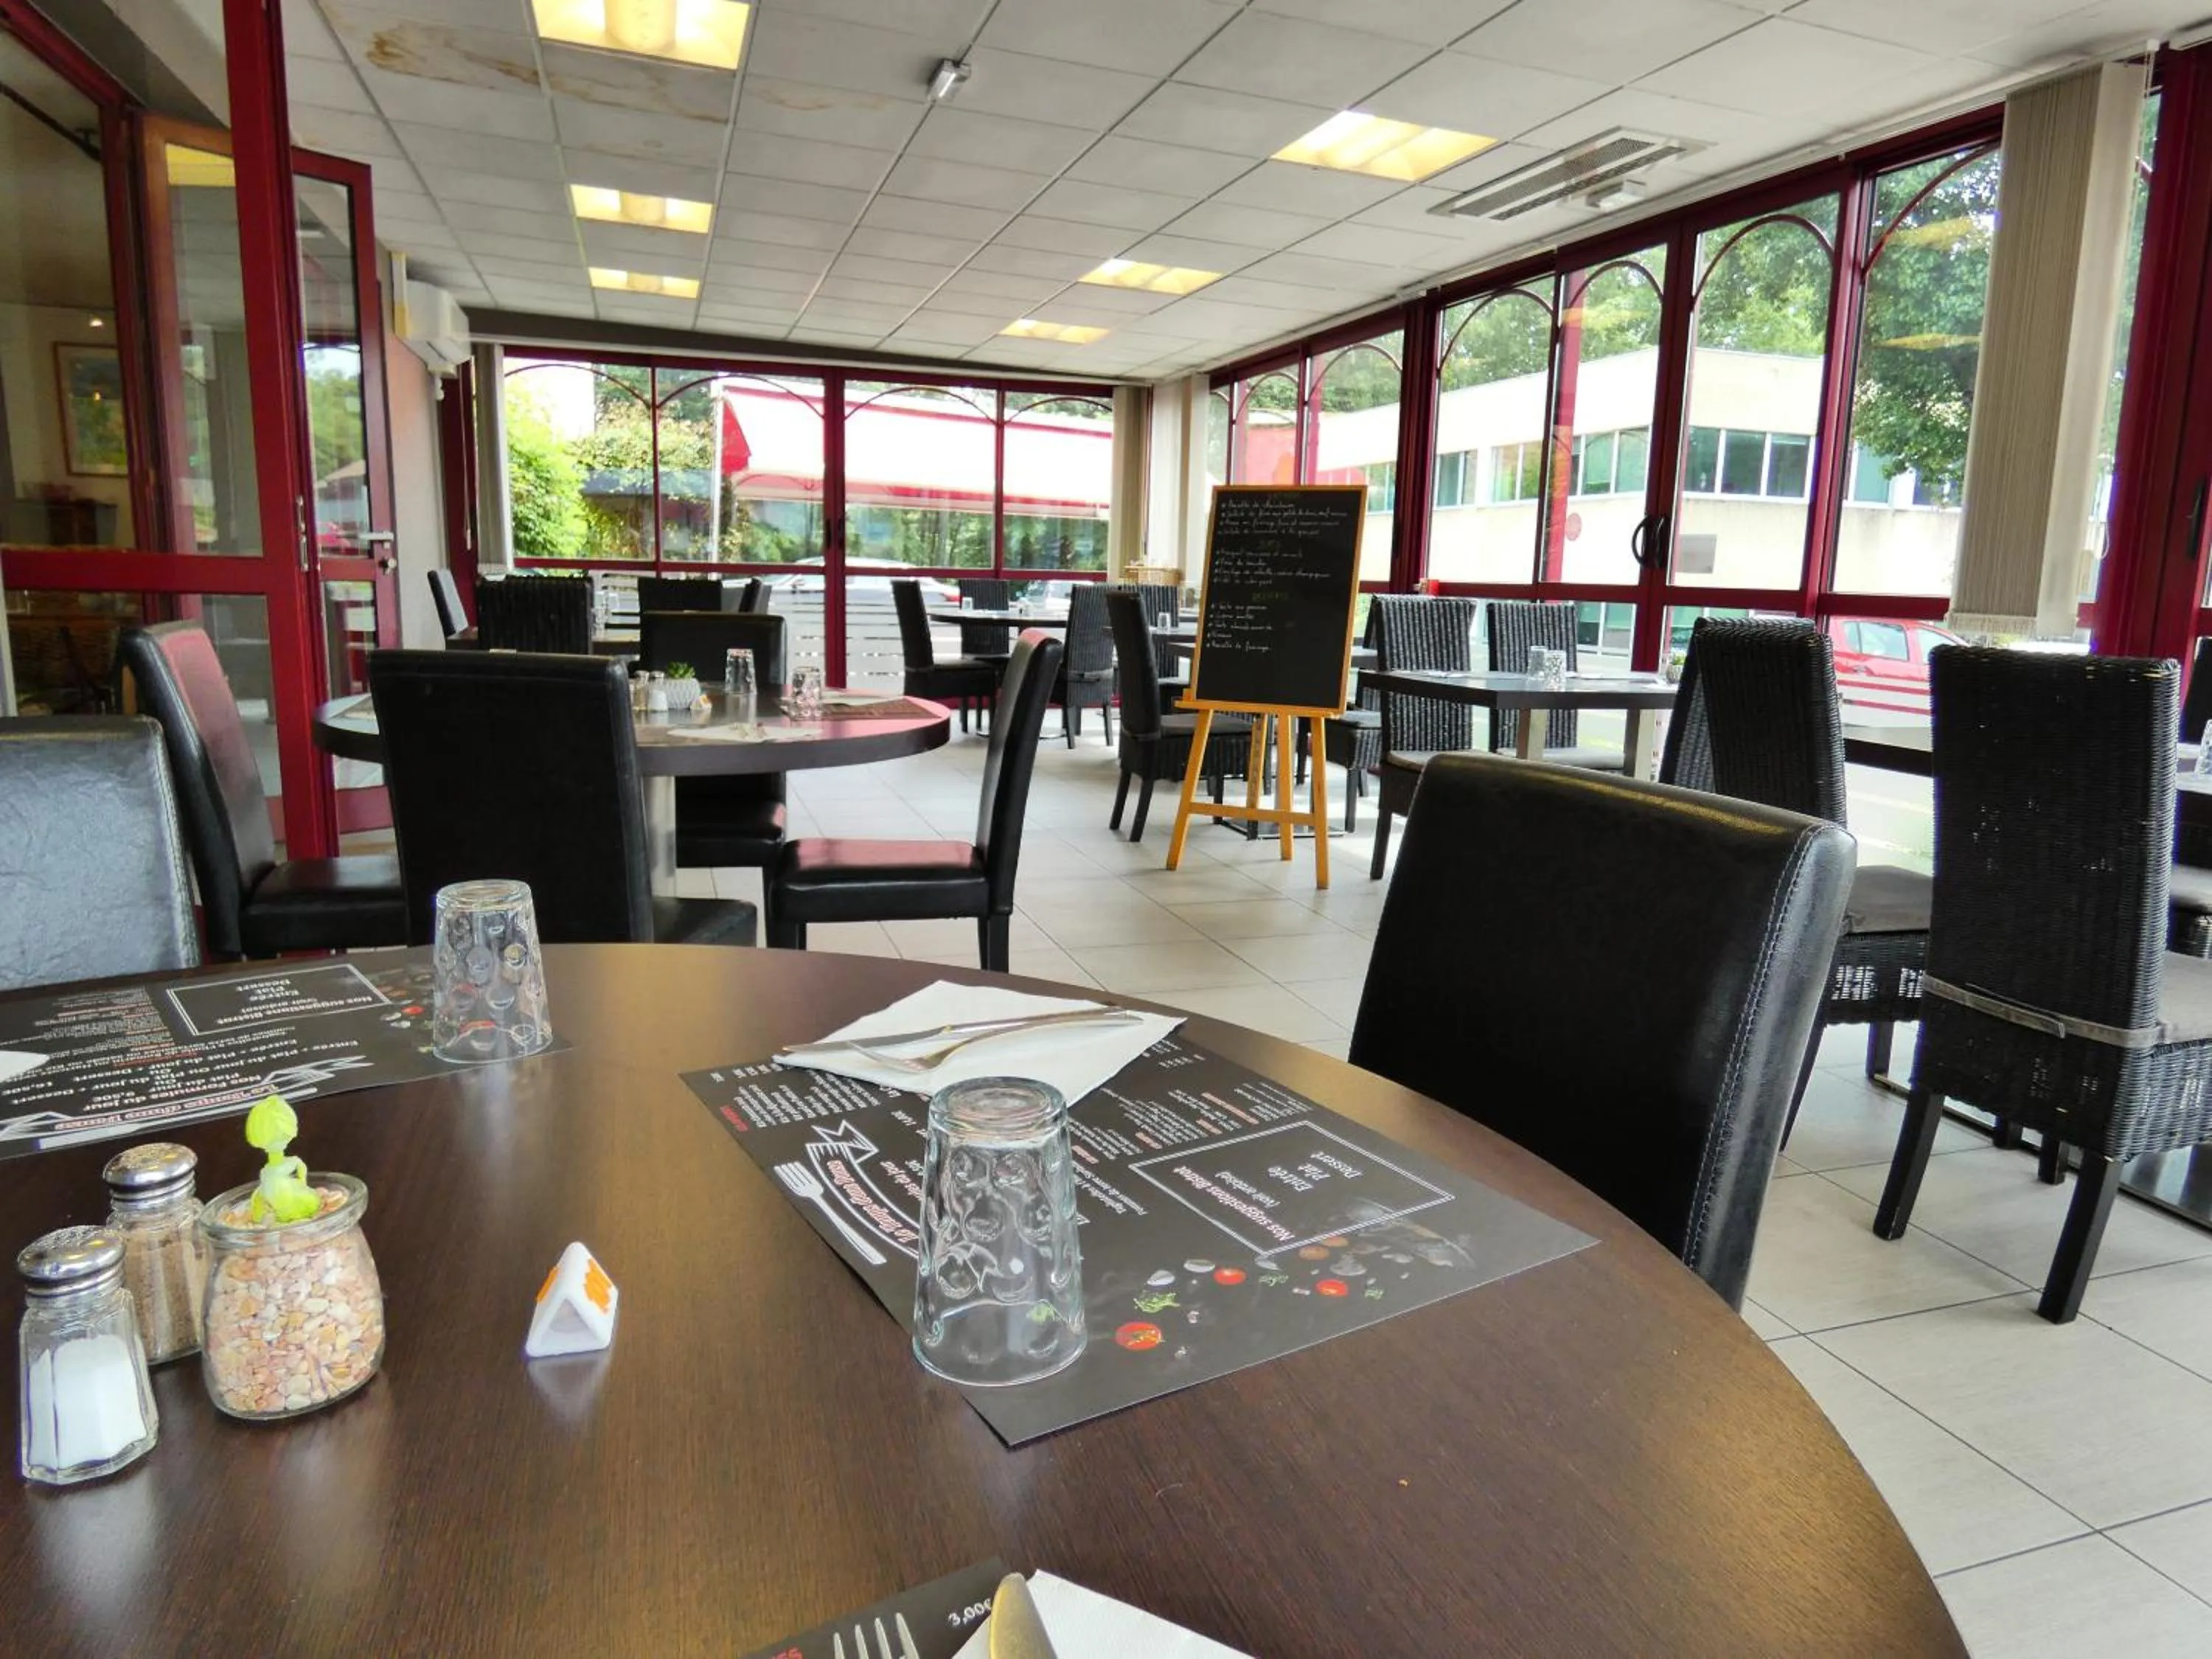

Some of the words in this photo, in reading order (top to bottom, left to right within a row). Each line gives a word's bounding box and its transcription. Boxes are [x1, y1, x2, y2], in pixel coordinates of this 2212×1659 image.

[251, 1039, 297, 1052] Entrée
[313, 1040, 358, 1050] Entrée
[208, 1052, 235, 1060] Plat
[271, 1049, 298, 1059] Plat
[149, 1060, 181, 1069] jour
[214, 1060, 244, 1070] jour
[74, 1068, 132, 1082] Dessert
[155, 1071, 184, 1080] Plat
[211, 1072, 240, 1082] Plat
[230, 1075, 261, 1084] Nos
[93, 1079, 126, 1090] jour
[149, 1082, 181, 1092] jour
[150, 1082, 226, 1099] Formules
[13, 1089, 74, 1104] Dessert
[84, 1099, 119, 1110] jour
[880, 1161, 905, 1175] jour
[1310, 1151, 1363, 1178] Dessert
[827, 1160, 855, 1185] Pause
[894, 1173, 911, 1183] du
[1173, 1166, 1212, 1189] Bistrot
[1267, 1166, 1313, 1192] Entrée
[1298, 1164, 1330, 1180] Plat
[843, 1182, 872, 1206] d'une
[1206, 1186, 1273, 1225] suggestions
[863, 1203, 902, 1231] Temps
[1266, 1224, 1295, 1241] Nos
[947, 1598, 992, 1627] 3,00€
